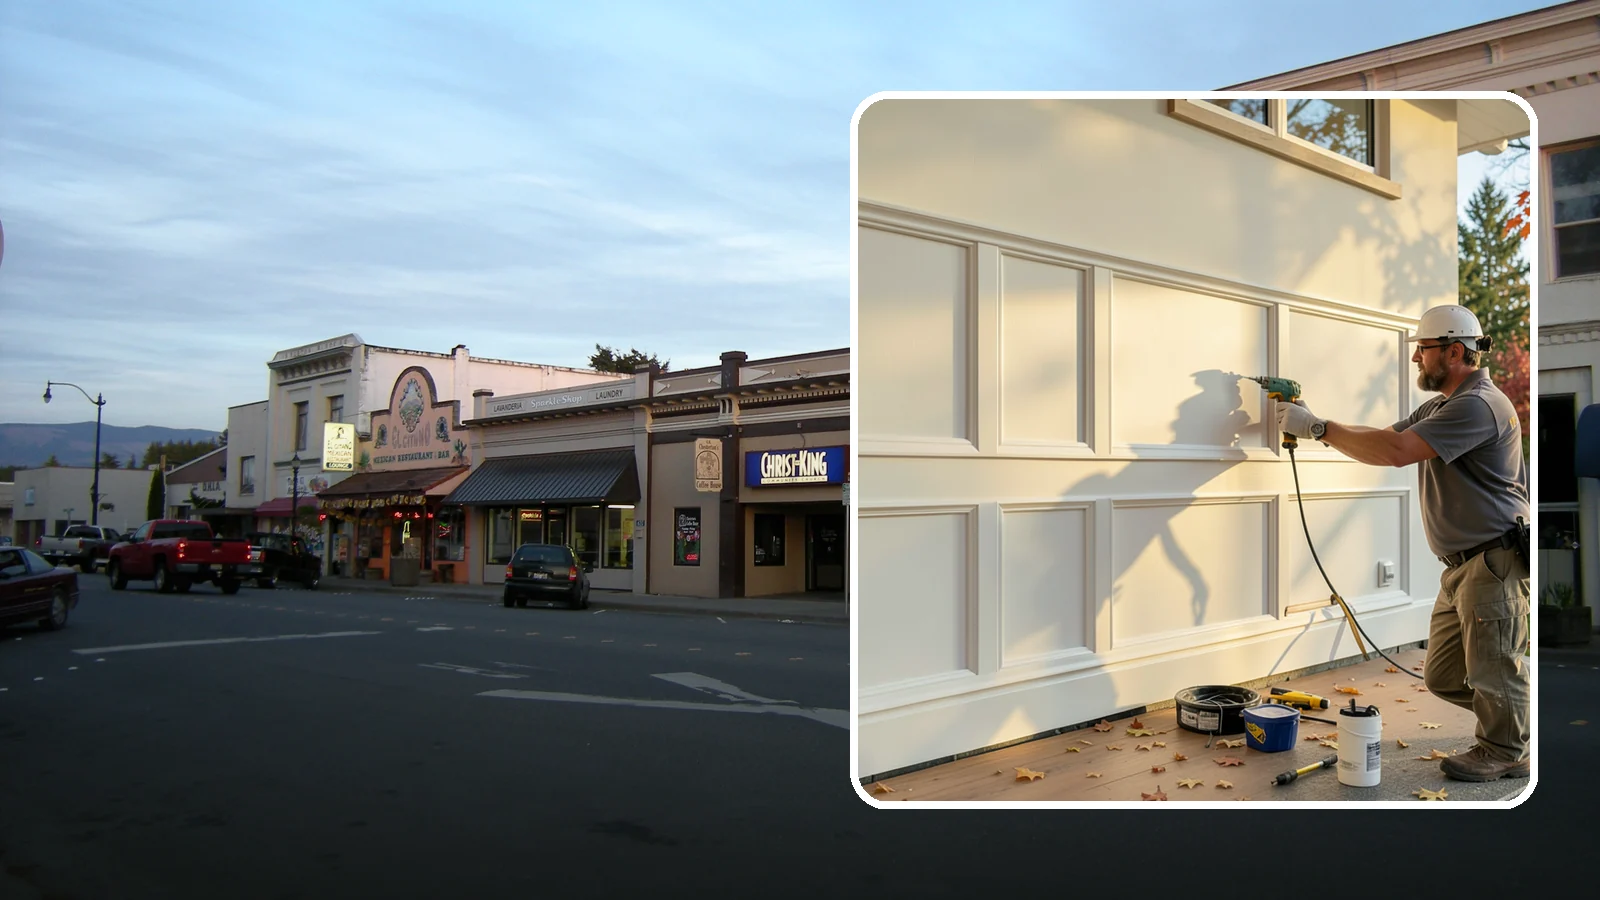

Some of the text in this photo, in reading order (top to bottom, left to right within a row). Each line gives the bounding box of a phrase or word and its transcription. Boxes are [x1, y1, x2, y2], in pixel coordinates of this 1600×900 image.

[561, 394, 583, 406] Shop
[595, 389, 623, 400] LAUNDRY
[493, 402, 523, 413] LAVANDERIA
[398, 451, 433, 462] RESTAURANT
[438, 450, 450, 459] BAR
[799, 450, 827, 476] KING
